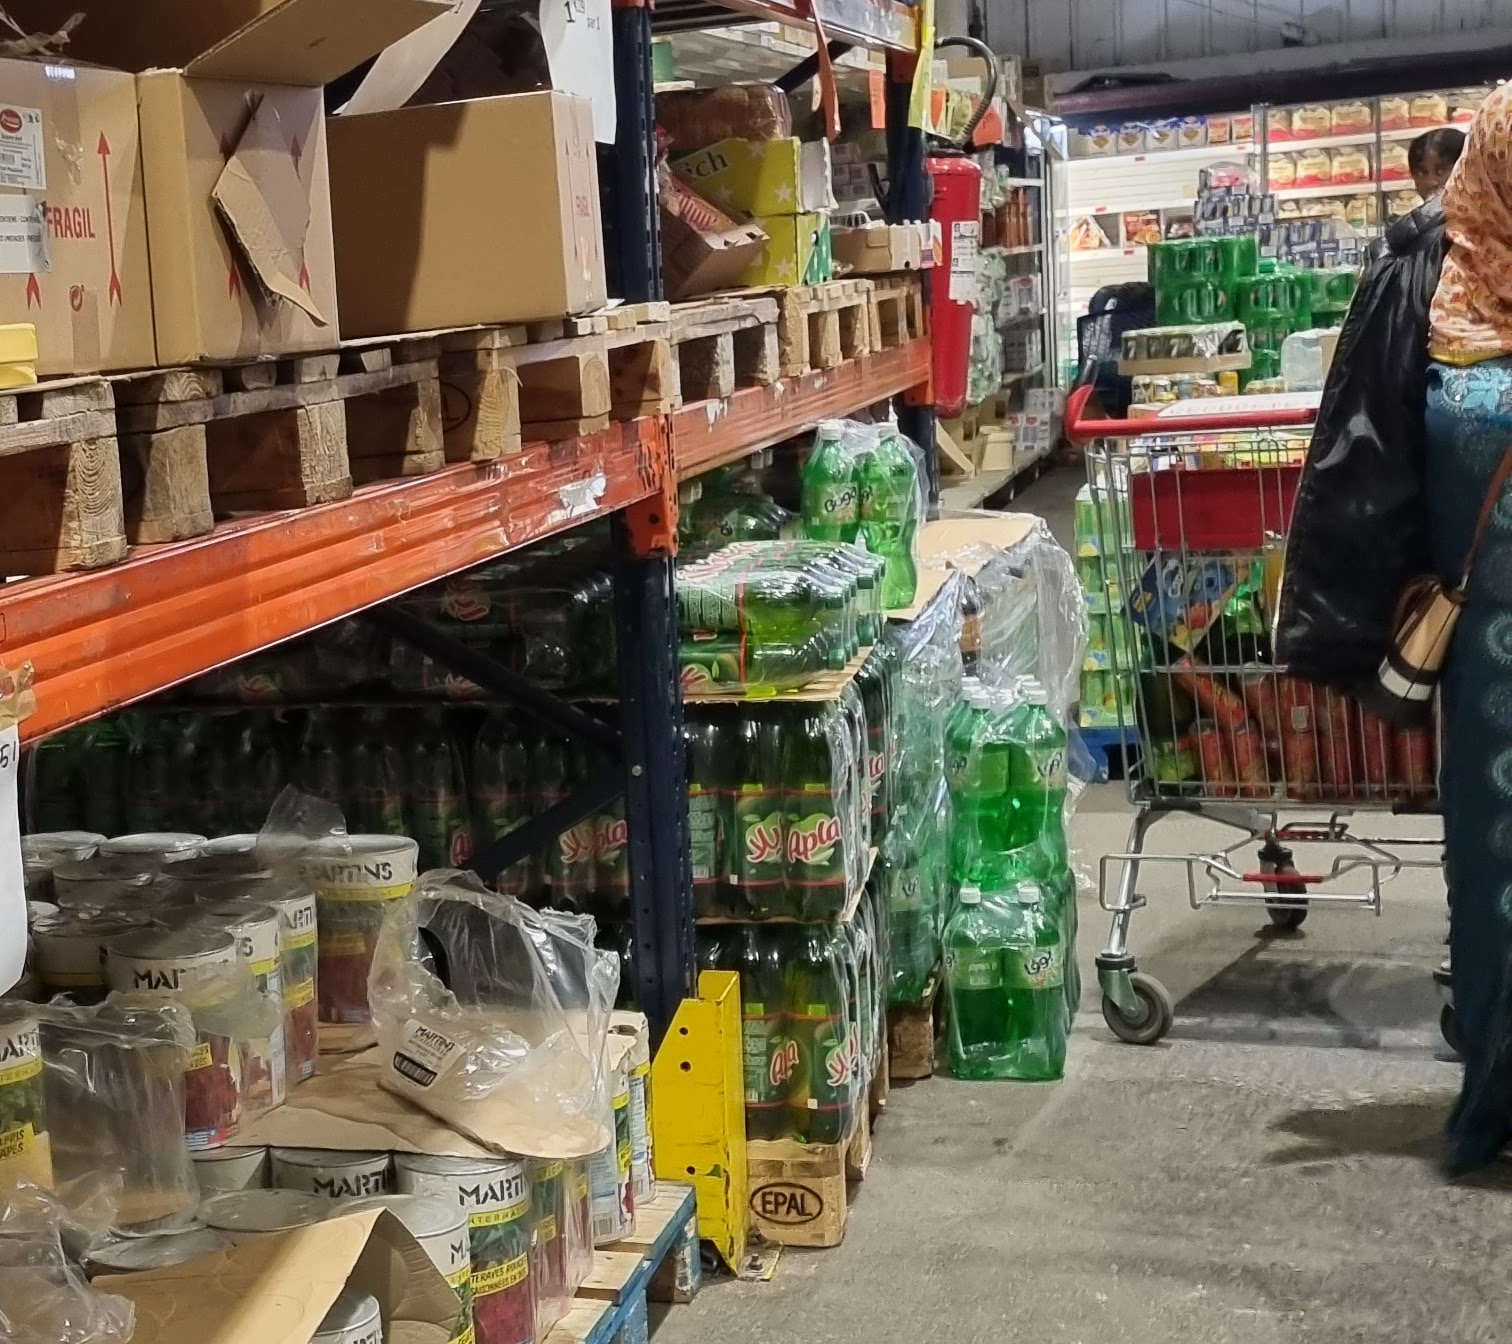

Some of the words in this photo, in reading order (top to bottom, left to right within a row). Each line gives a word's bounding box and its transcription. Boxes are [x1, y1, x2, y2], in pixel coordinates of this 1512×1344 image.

[44, 206, 97, 239] FRAGIL
[788, 815, 843, 864] Apla
[415, 1026, 456, 1052] MARTINS
[761, 1190, 814, 1217] EPAL
